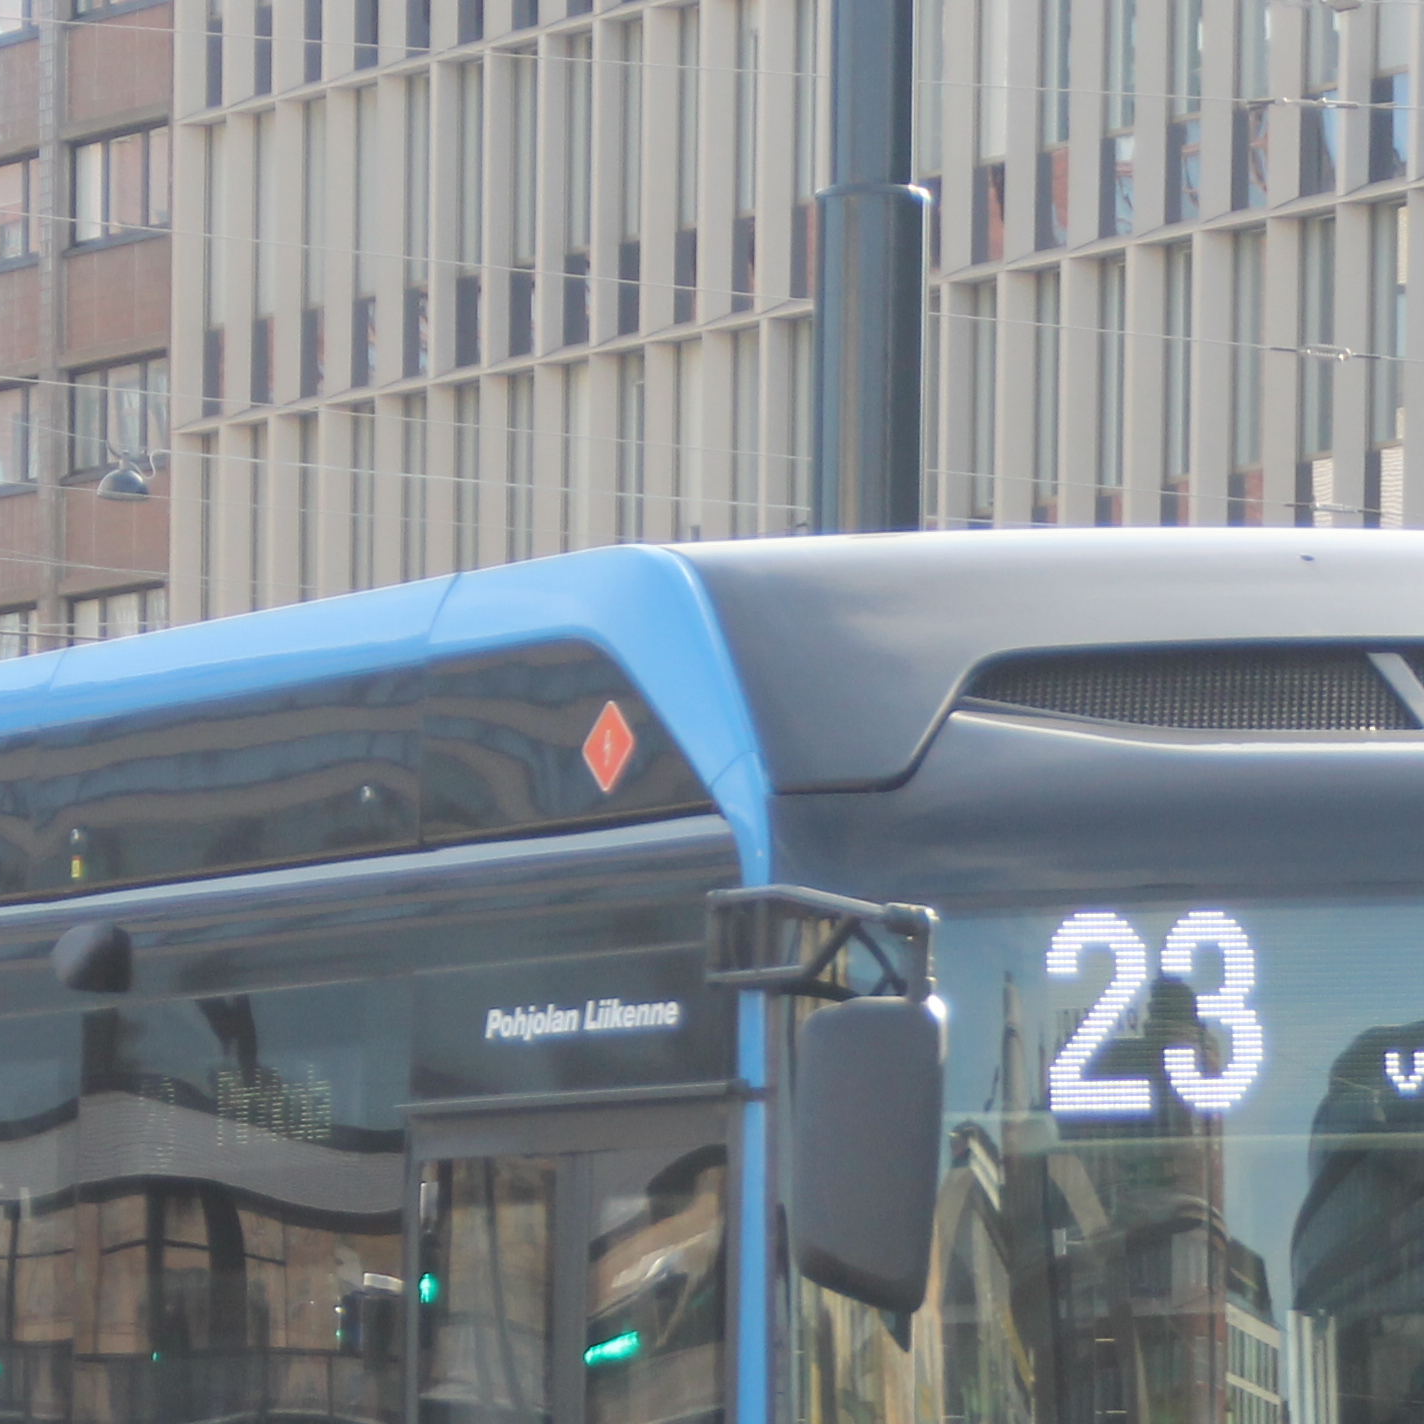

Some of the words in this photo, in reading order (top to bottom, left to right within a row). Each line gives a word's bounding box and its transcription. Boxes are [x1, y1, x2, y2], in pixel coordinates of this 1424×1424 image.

[484, 1004, 579, 1041] Pohjolan
[583, 998, 679, 1031] Liikenne
[1044, 911, 1266, 1114] 23
